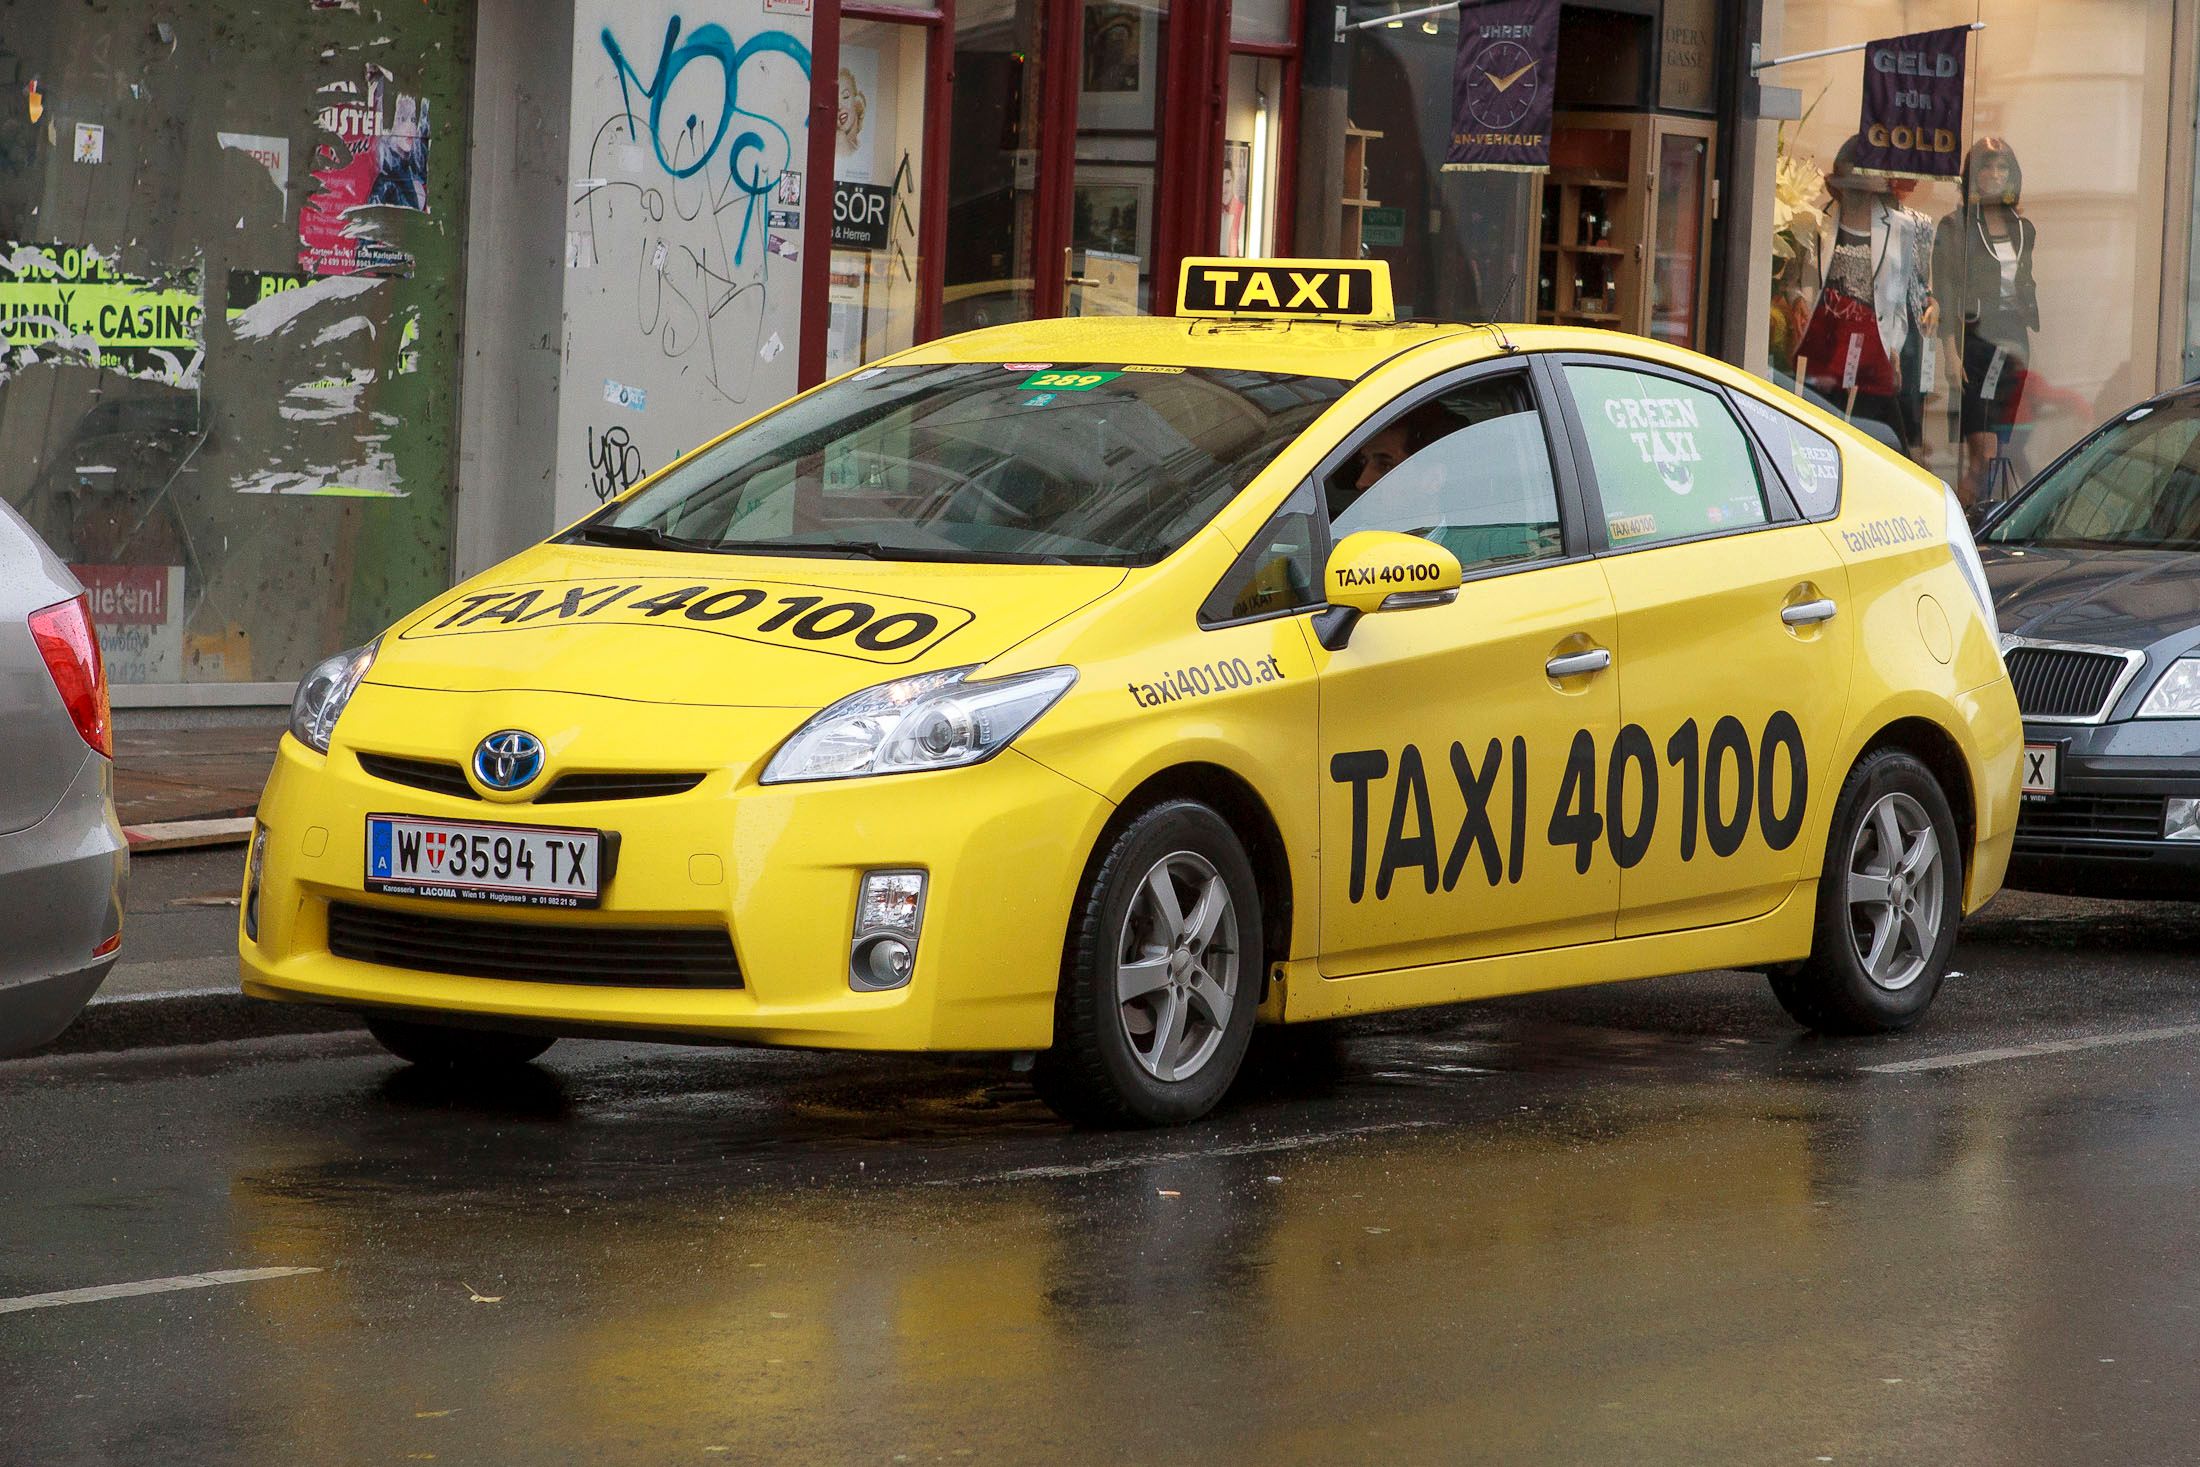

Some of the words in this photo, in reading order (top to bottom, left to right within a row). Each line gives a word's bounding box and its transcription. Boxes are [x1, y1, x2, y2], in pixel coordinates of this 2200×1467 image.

[1480, 25, 1534, 39] UHREN
[1873, 48, 1958, 78] GELD
[1895, 89, 1932, 110] FÜR
[1454, 133, 1543, 147] AN-VERKAUF
[1867, 123, 1956, 153] GOLD
[833, 187, 885, 225] SÖR
[843, 228, 871, 241] Herren
[1203, 270, 1350, 309] TAXI
[1031, 374, 1102, 387] 289
[1605, 398, 1699, 430] GREEN
[1631, 431, 1702, 463] TAXI
[1801, 447, 1835, 462] GREEN
[1810, 464, 1839, 479] TAXI
[1610, 521, 1631, 537] TAXI
[1842, 514, 1933, 553] taxi40100.at
[1336, 567, 1376, 587] TAXI
[1380, 563, 1440, 583] 40100
[434, 584, 642, 629] TAXI
[1127, 654, 1285, 708] taxi40100.at
[2024, 752, 2045, 785] X
[1330, 735, 1527, 904] TAXI
[1548, 710, 1809, 875] 40100
[378, 857, 387, 869] A
[397, 829, 422, 873] W
[449, 834, 536, 882] 3594
[546, 840, 587, 886] TX
[383, 884, 416, 894] Karosserie
[420, 887, 457, 898] LACOMA
[462, 890, 478, 899] Wien
[478, 891, 486, 899] 15
